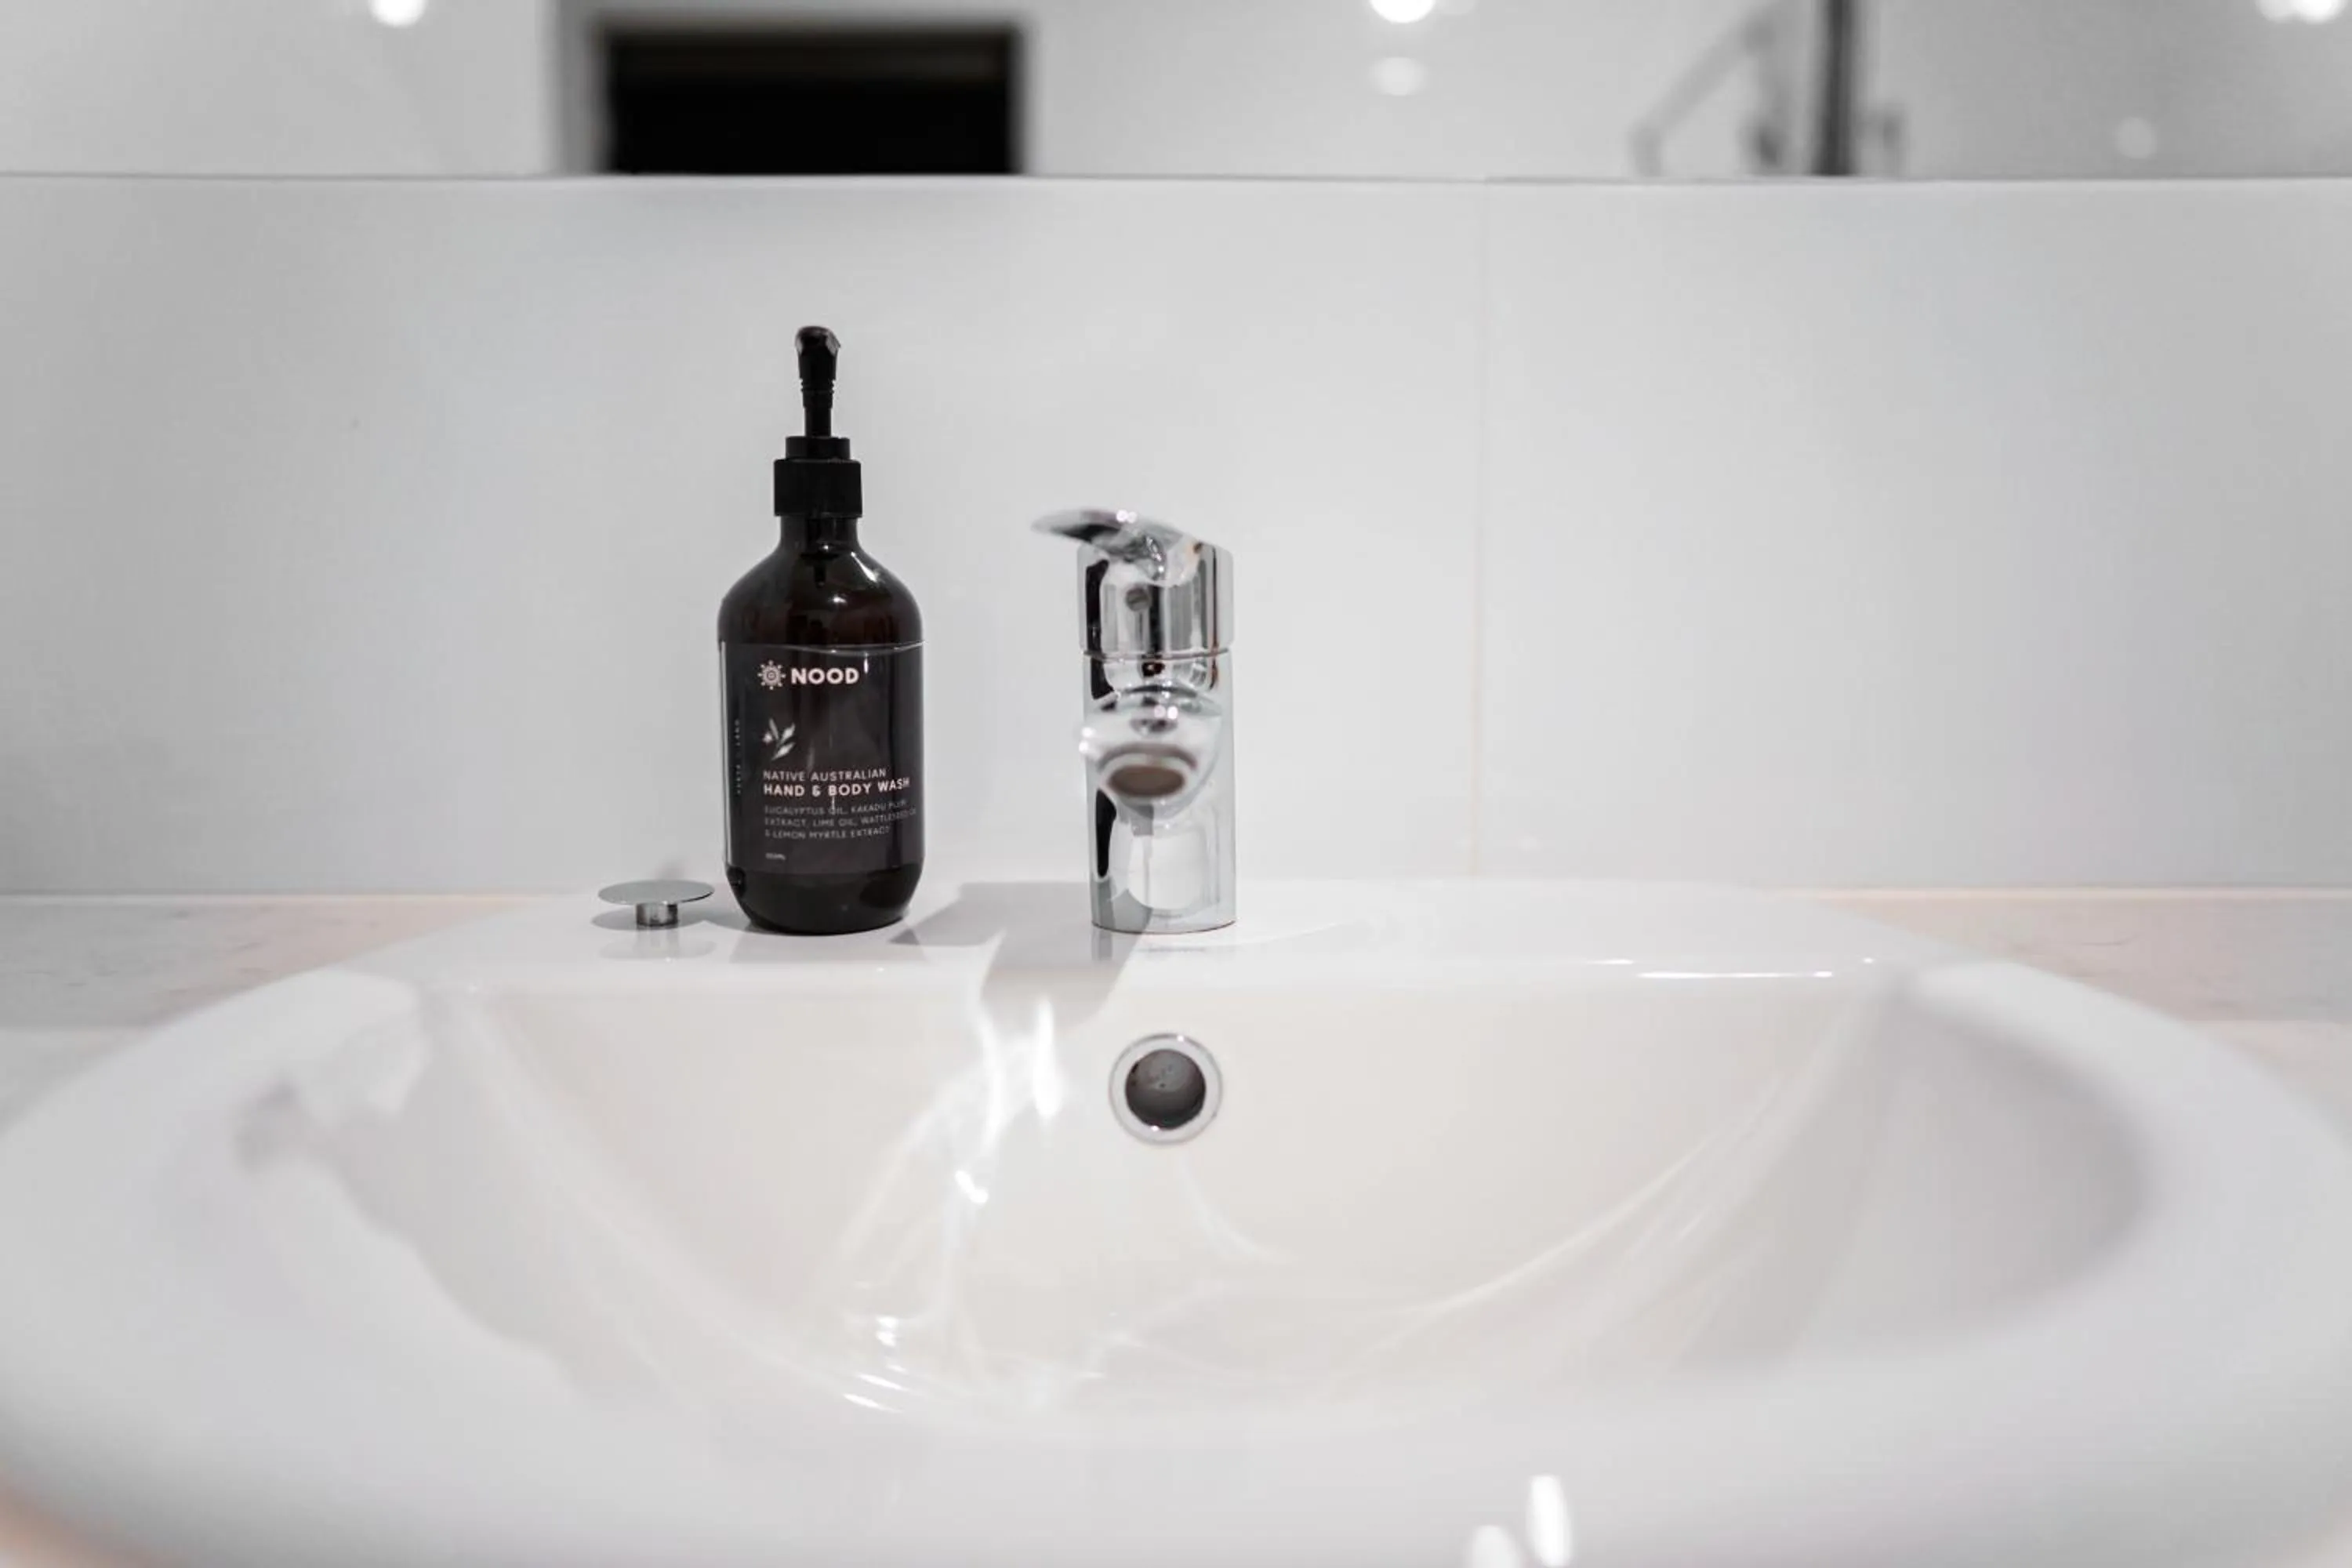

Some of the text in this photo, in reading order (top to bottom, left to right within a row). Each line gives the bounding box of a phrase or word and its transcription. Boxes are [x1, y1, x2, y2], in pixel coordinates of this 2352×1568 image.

[791, 668, 859, 684] NOOD
[763, 768, 887, 782] NATIVE AUSTRALIAN
[764, 777, 910, 797] HAND & BODY WASH
